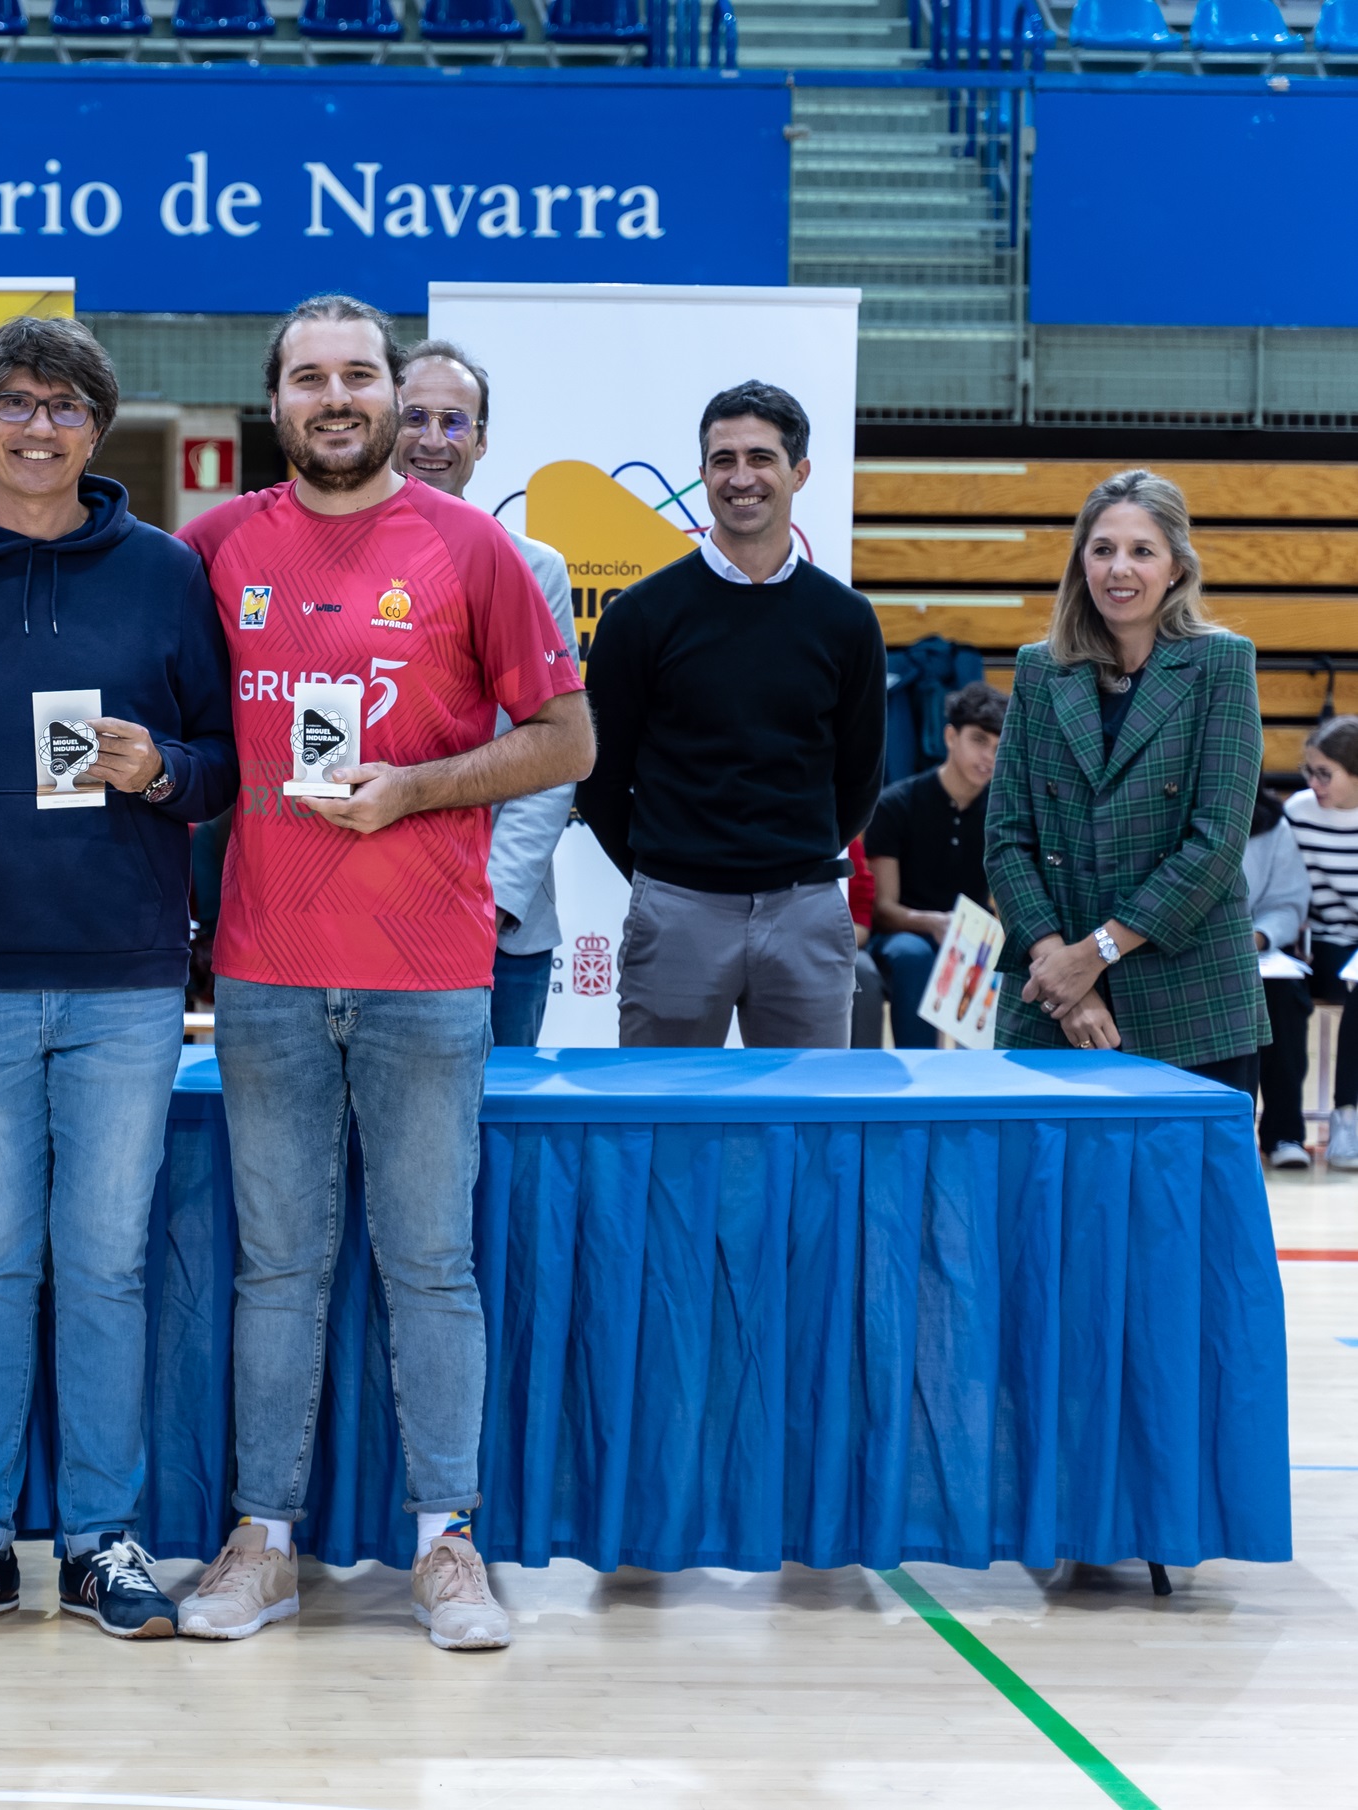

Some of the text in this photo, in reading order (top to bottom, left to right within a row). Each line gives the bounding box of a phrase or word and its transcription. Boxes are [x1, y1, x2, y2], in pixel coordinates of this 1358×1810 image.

[160, 150, 262, 237] de
[302, 161, 667, 239] Navarra
[567, 560, 642, 576] ndación
[315, 603, 342, 613] WIBO
[370, 618, 413, 631] NAVARRA
